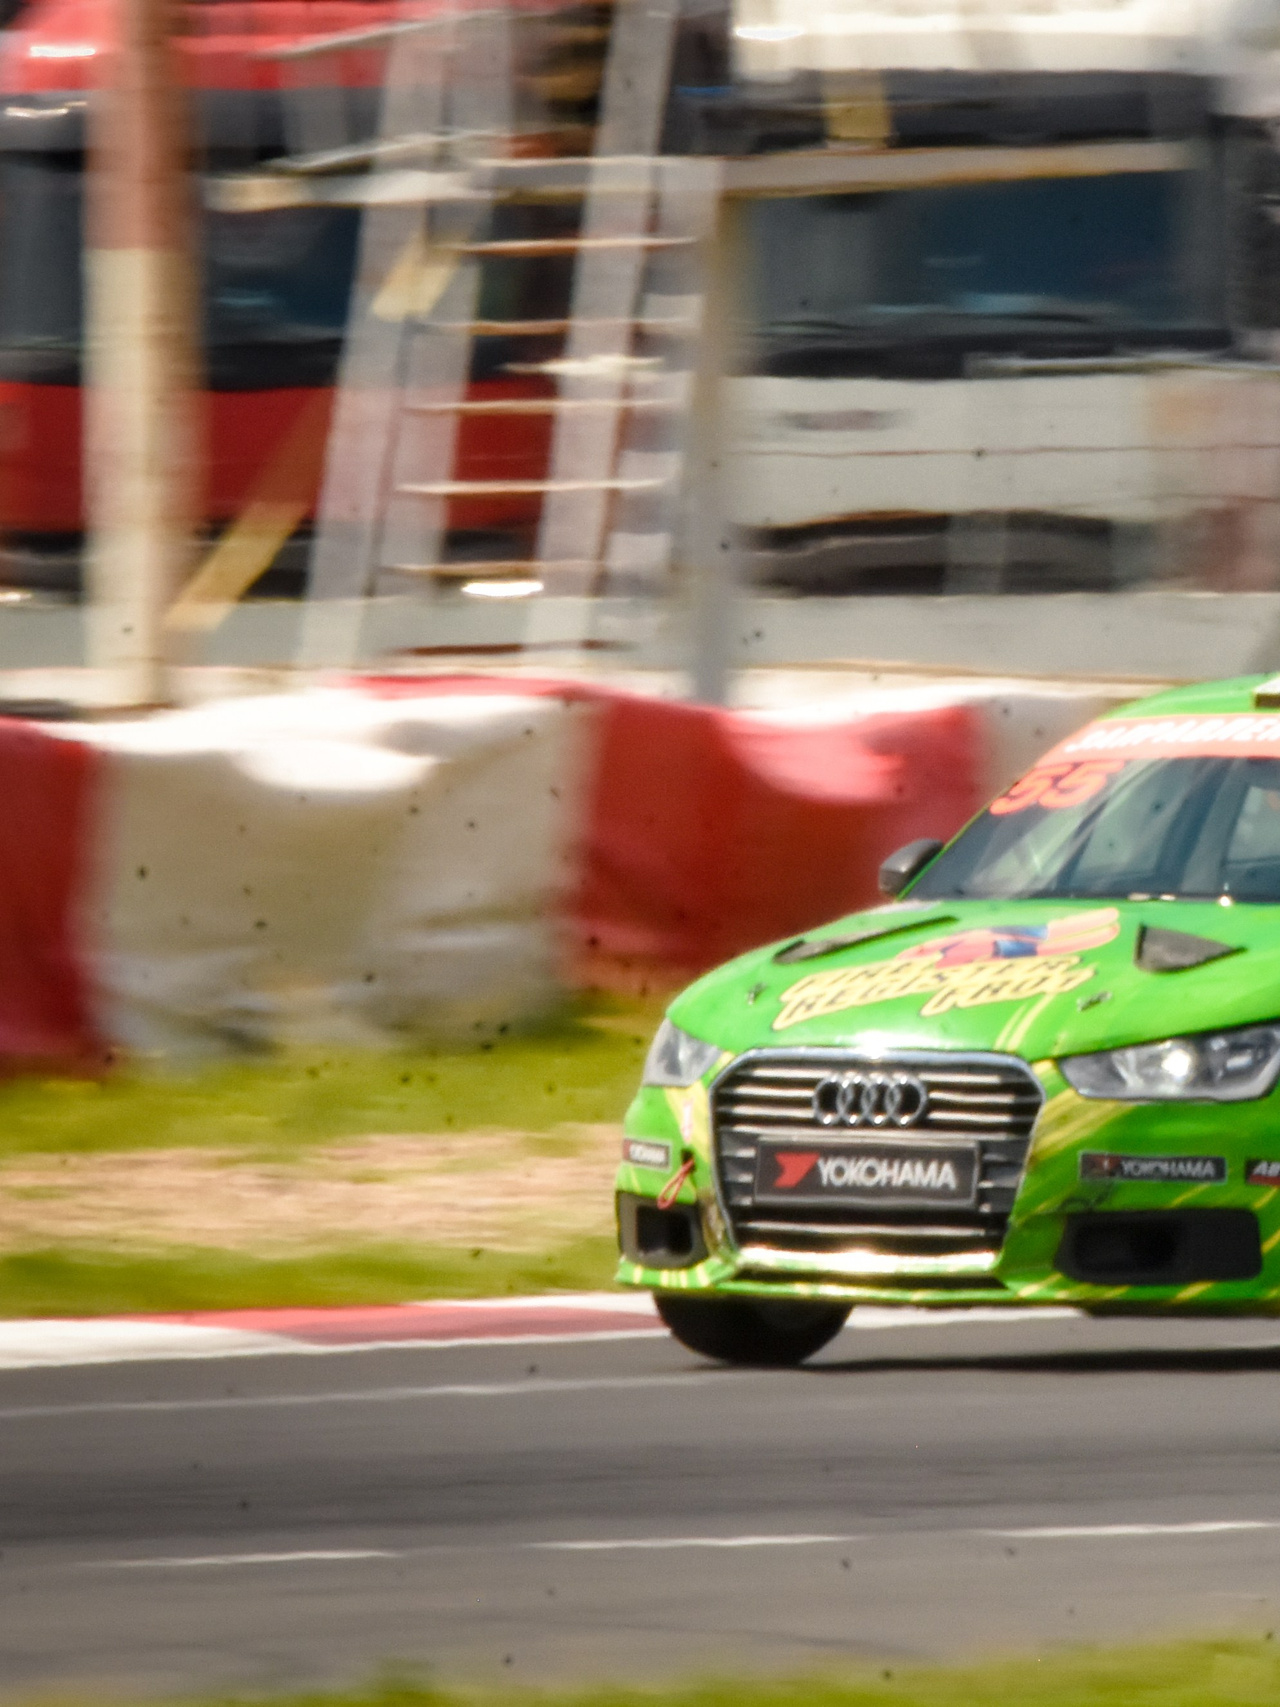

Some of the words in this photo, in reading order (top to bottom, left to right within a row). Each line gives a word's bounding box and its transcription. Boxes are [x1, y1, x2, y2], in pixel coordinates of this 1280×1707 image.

[989, 760, 1126, 815] 55
[817, 1155, 958, 1191] YOKOHAMA
[1121, 1159, 1216, 1178] YOKOHAMA
